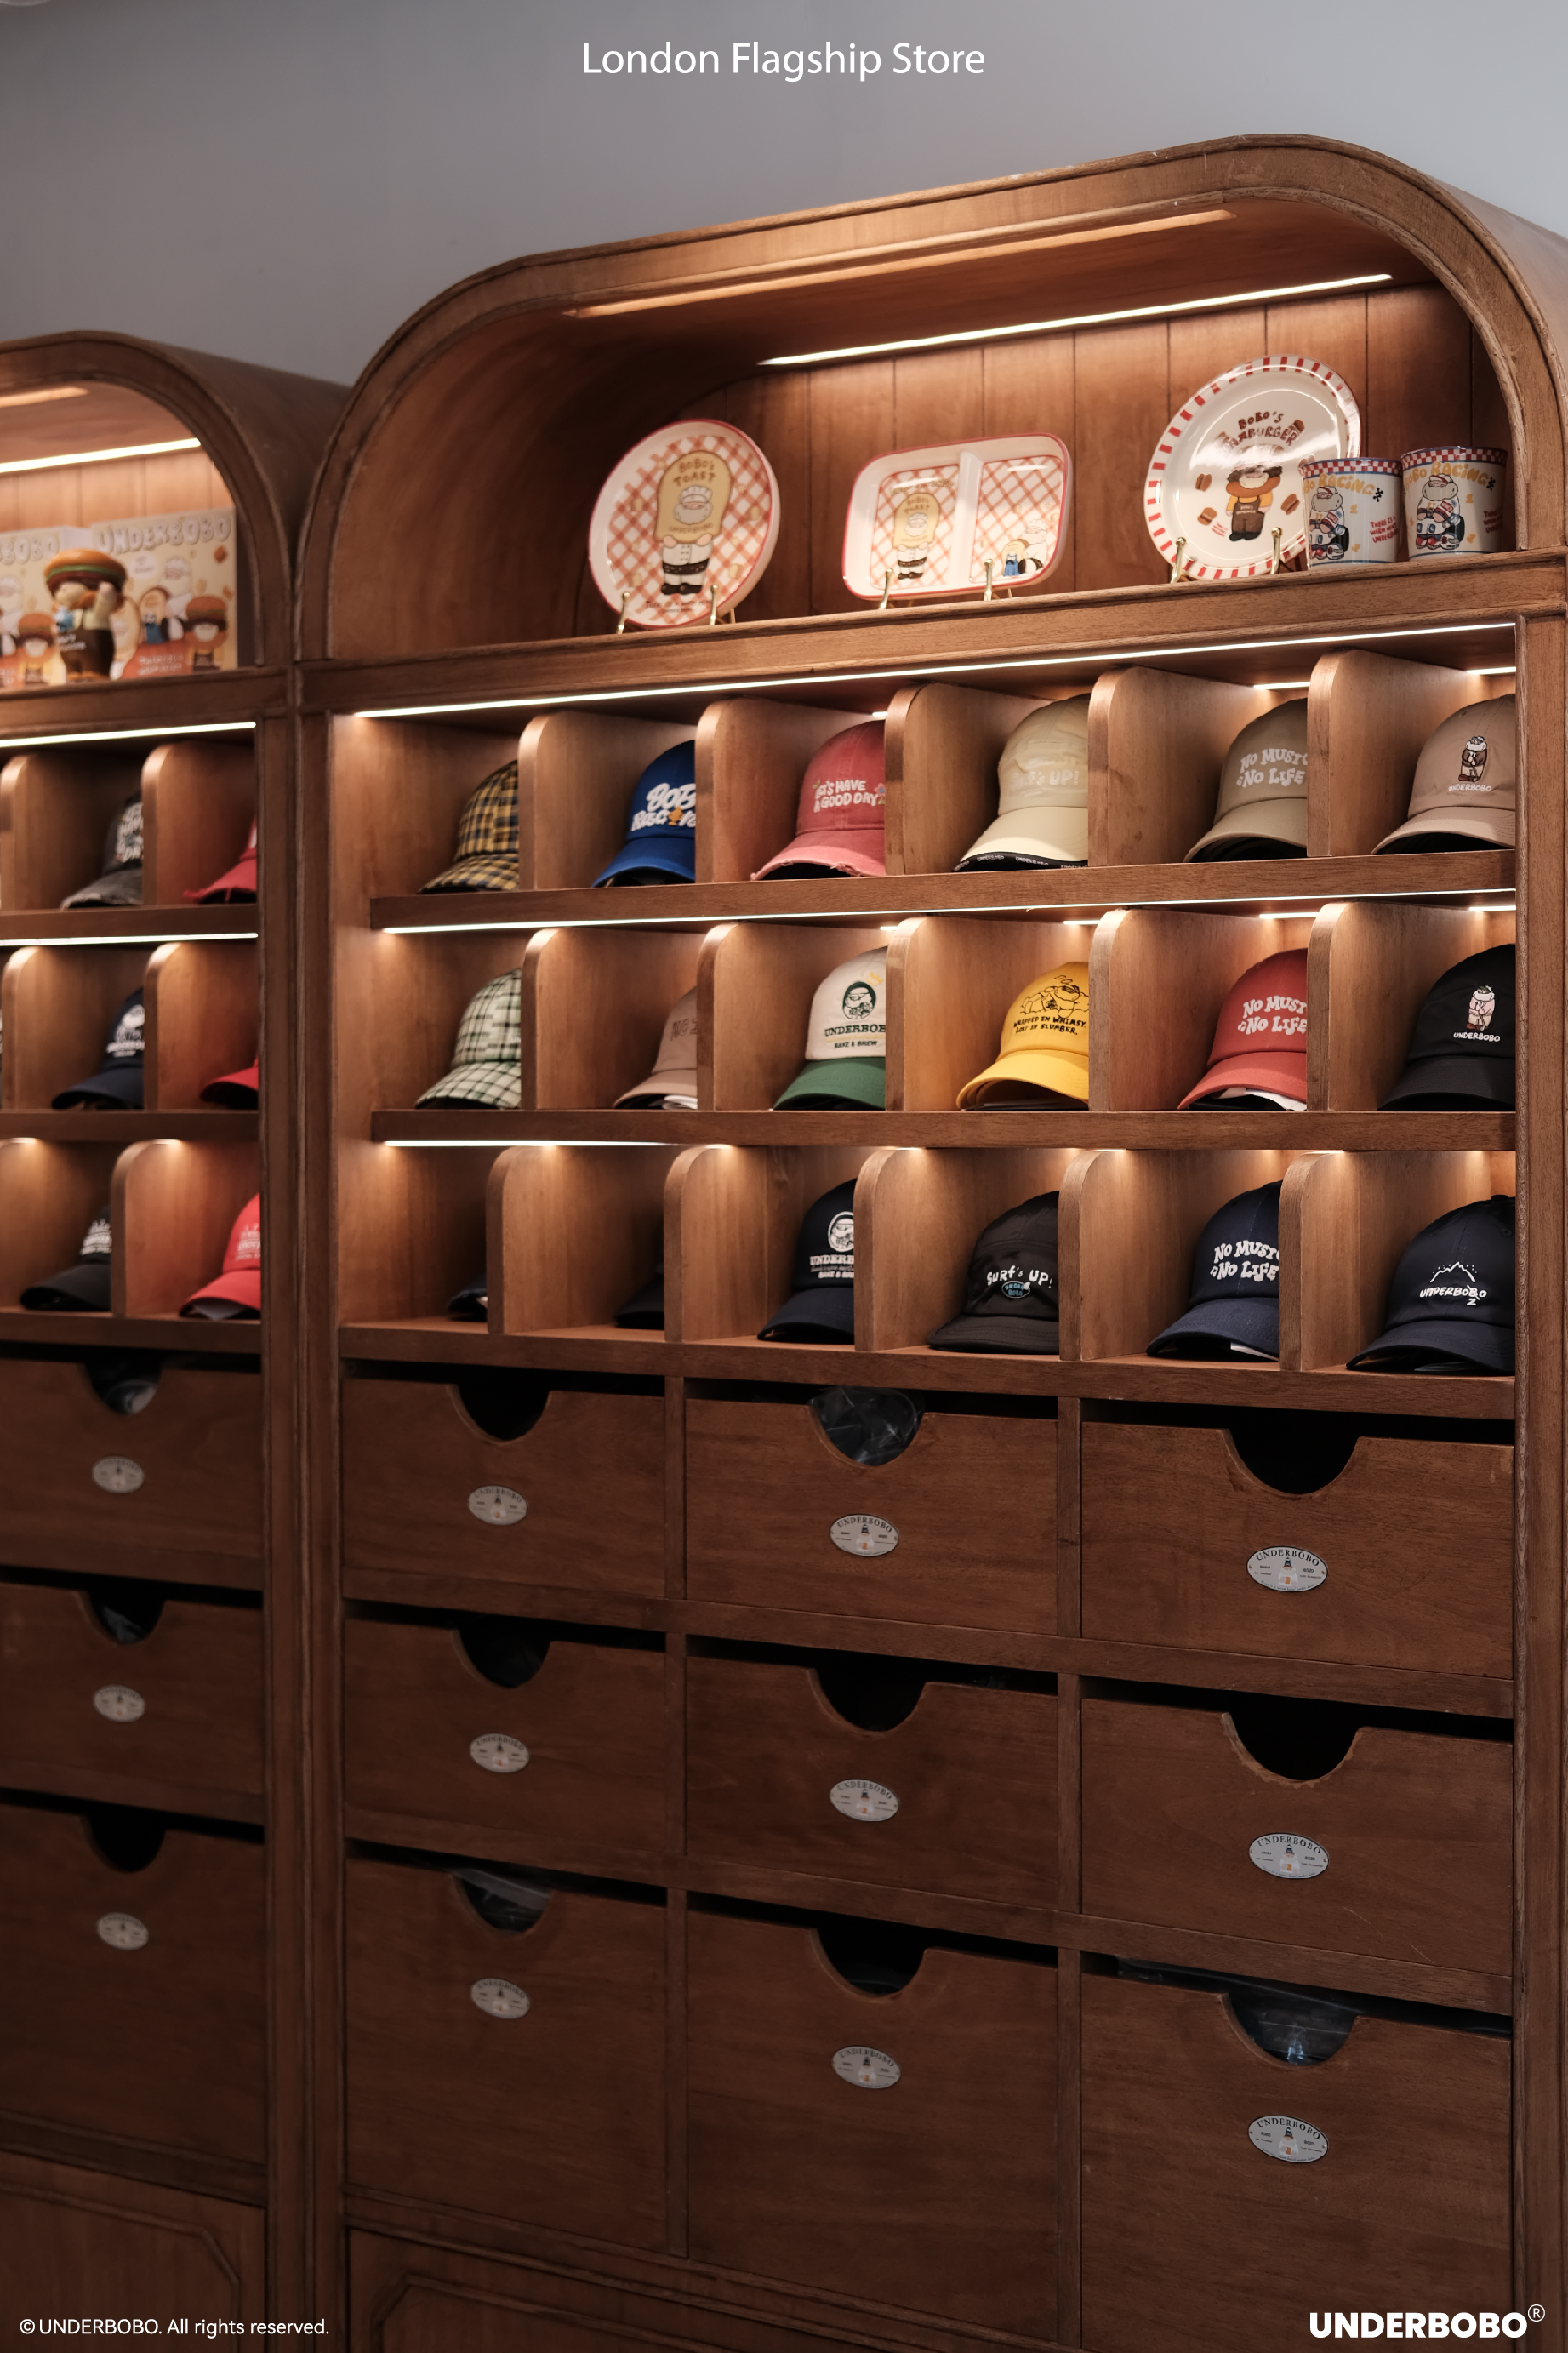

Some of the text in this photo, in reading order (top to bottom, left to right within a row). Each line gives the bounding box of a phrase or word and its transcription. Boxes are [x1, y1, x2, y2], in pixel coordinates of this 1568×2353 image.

[1226, 425, 1298, 448] AMBURGER
[1240, 752, 1258, 774] NO
[835, 779, 867, 793] HAVE
[1049, 769, 1080, 786] UP!
[1241, 768, 1306, 788] NO LIFE
[1448, 783, 1492, 792] UNDERBOBO
[821, 792, 852, 808] GOOD
[852, 792, 879, 807] DAY
[1242, 998, 1263, 1019] NO
[1245, 1015, 1307, 1036] NO LIFE
[835, 1041, 850, 1050] BAKE
[1453, 1031, 1501, 1042] UNDERBOBO
[1213, 1242, 1233, 1264] NO
[1217, 1260, 1279, 1282] NO LIFE
[1419, 1283, 1487, 1300] UNDERBOBO
[836, 1516, 892, 1533] UNDERBOBO
[1255, 1549, 1320, 1567] UNDERBOBO
[1257, 1836, 1320, 1854] UNDERBOBO
[1257, 2117, 1320, 2140] UNDERBOBO
